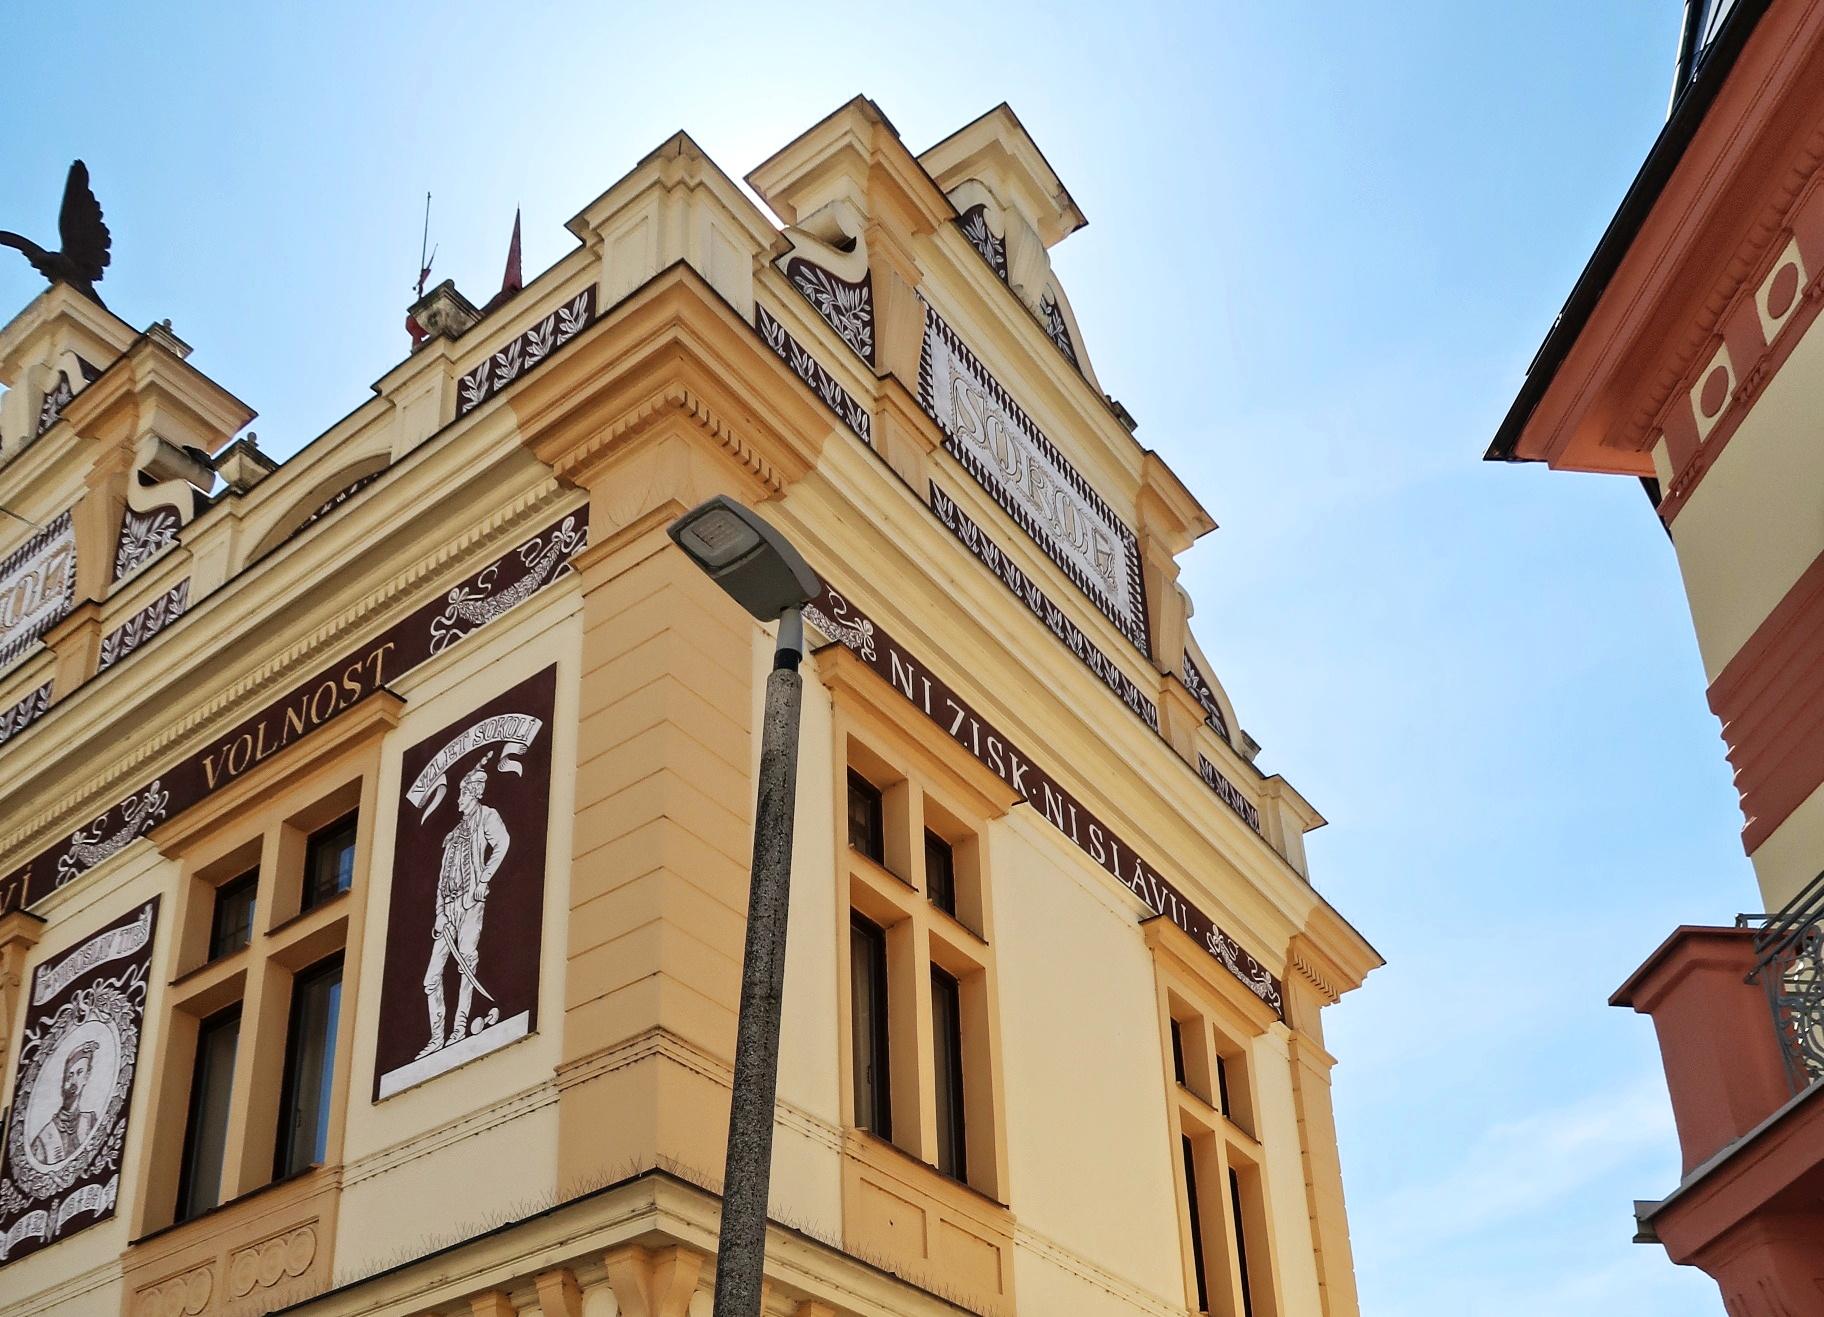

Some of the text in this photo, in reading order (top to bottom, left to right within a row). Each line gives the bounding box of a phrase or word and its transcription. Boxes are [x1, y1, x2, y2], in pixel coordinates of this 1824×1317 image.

[202, 641, 395, 790] VOLNOST
[889, 648, 932, 716] NI
[1042, 781, 1081, 846] NI
